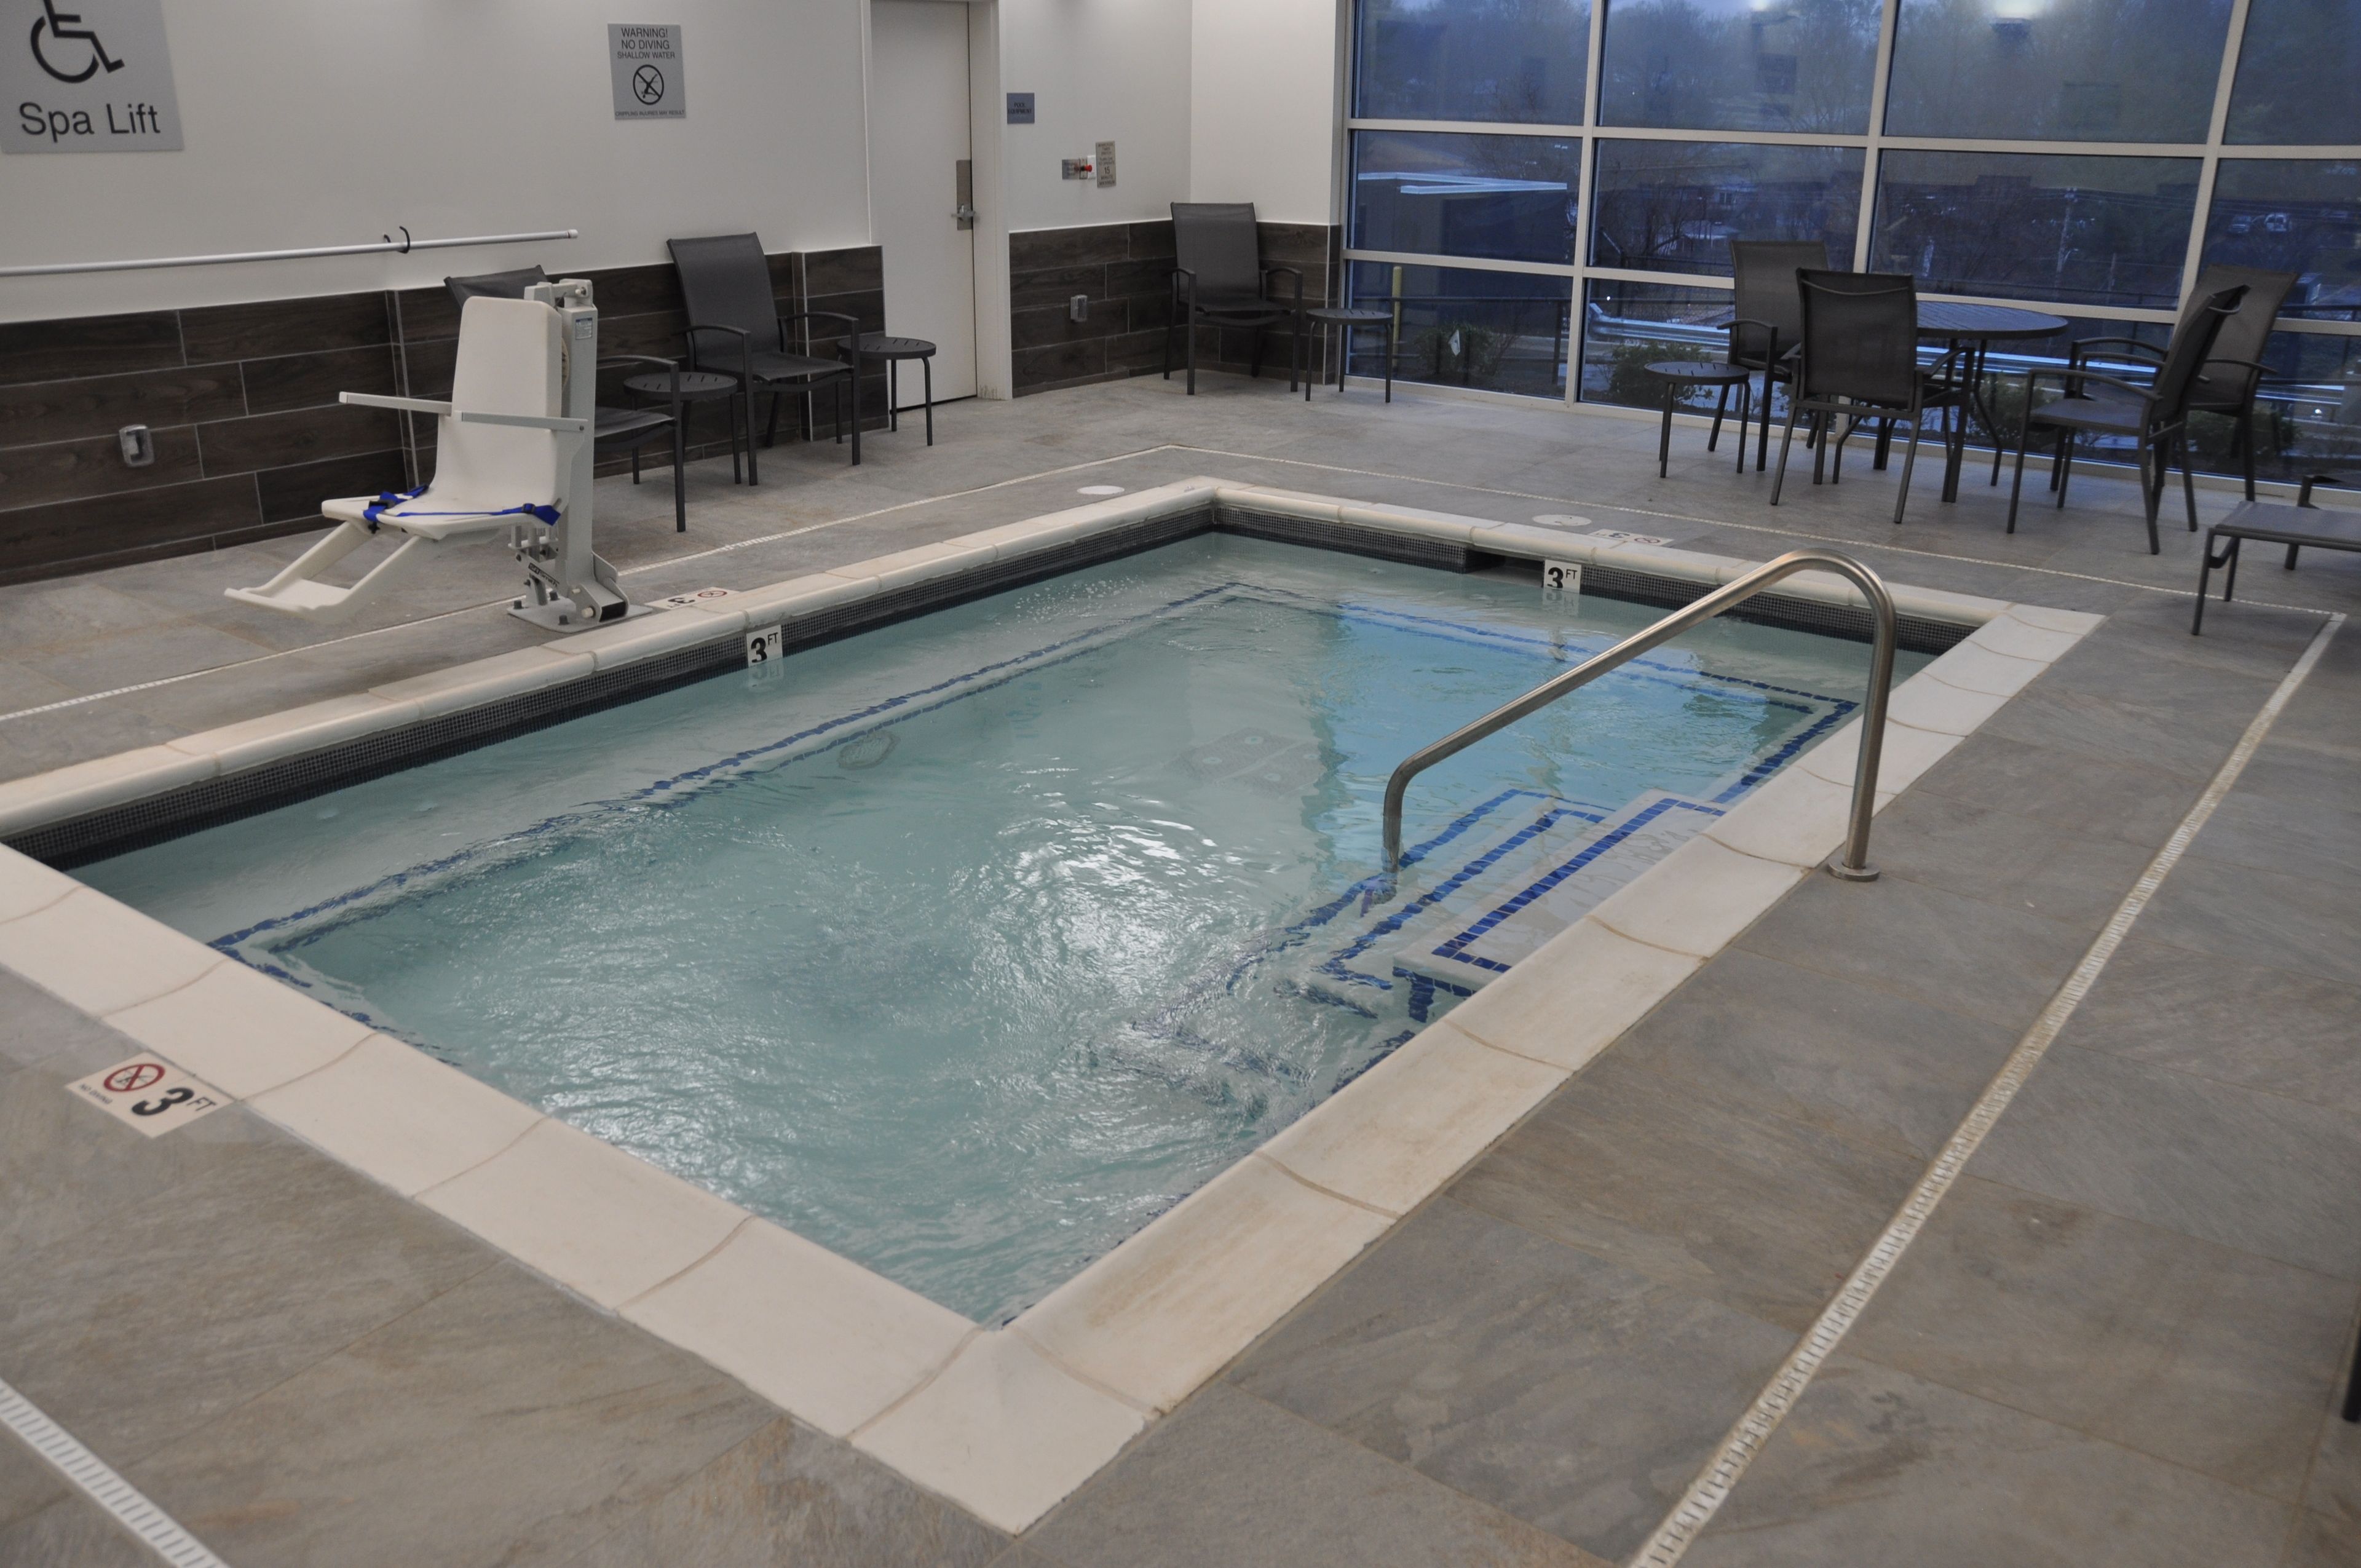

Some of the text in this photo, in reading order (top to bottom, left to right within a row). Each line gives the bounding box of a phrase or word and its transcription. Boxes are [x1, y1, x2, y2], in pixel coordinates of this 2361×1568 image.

[621, 28, 668, 38] WARNING!
[622, 39, 670, 50] NO DIVING
[19, 102, 160, 143] Spa Lift
[1104, 166, 1110, 175] 15
[1547, 567, 1578, 588] 3 FT
[751, 632, 778, 663] 3 FT
[131, 1087, 217, 1116] 3 FT
